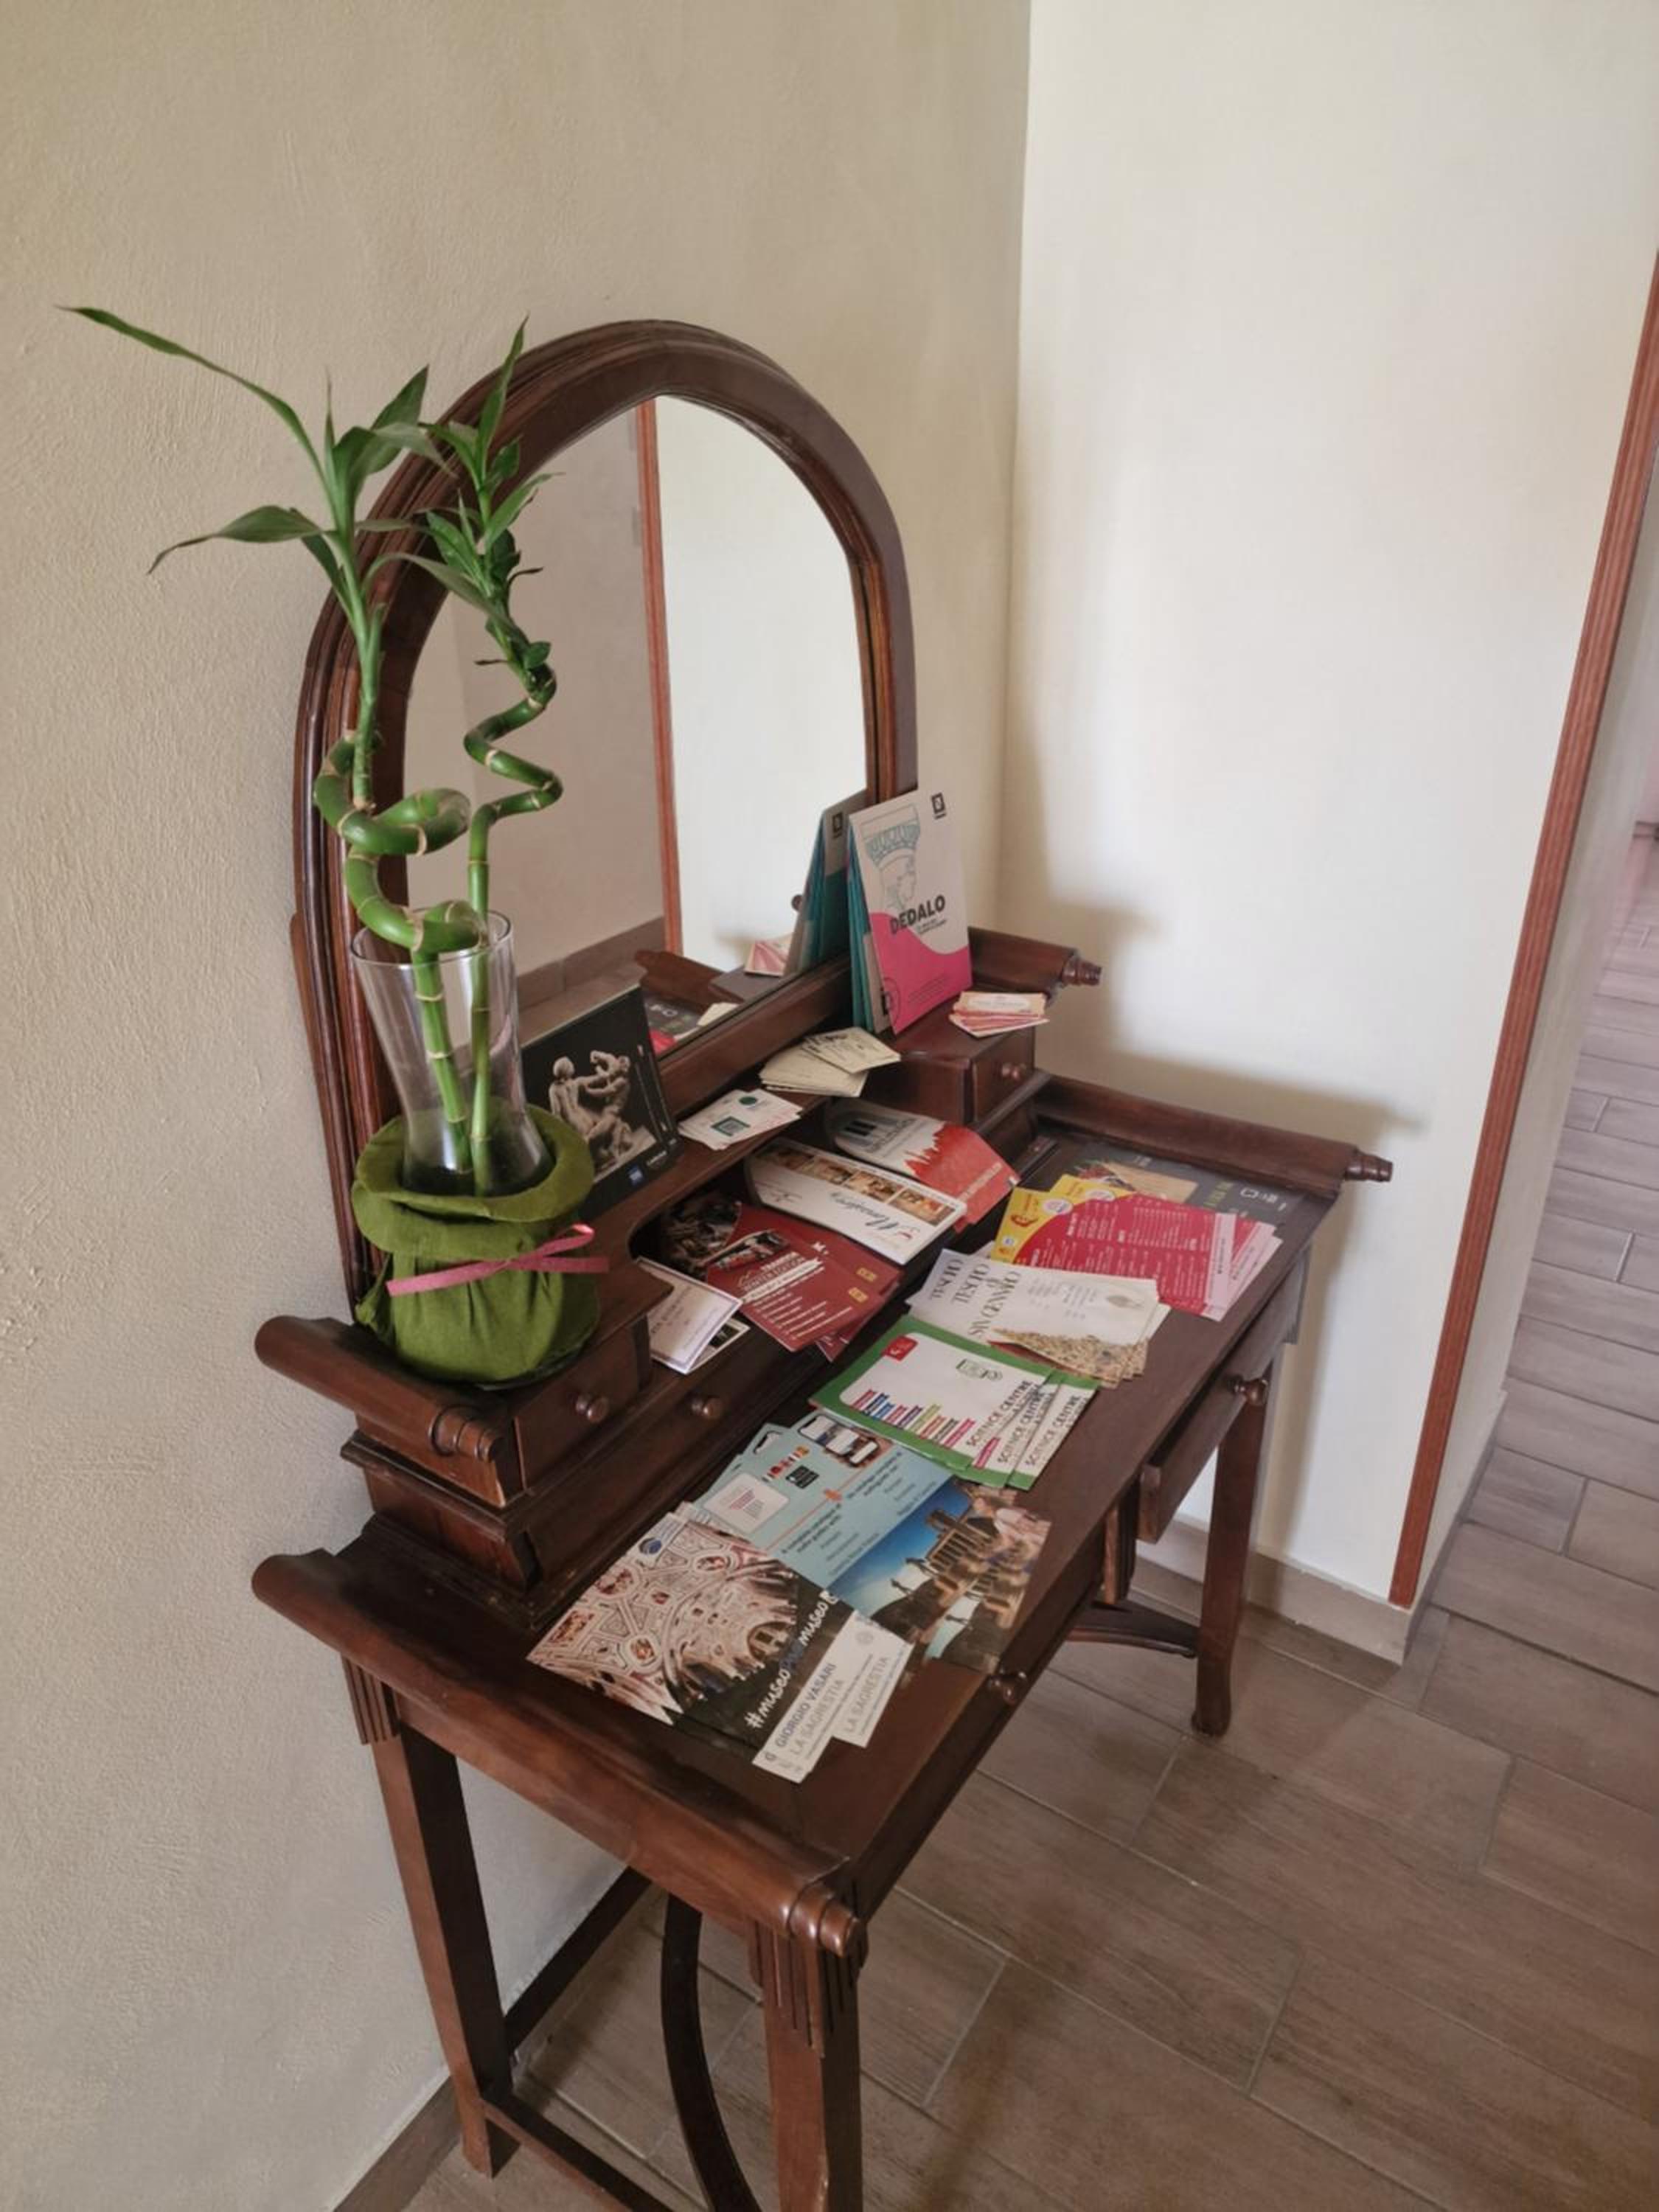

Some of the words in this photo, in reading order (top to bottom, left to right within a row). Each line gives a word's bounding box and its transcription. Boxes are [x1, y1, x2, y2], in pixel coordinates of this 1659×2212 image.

[890, 894, 946, 936] DEDALO
[967, 1411, 1002, 1446] SCIENCE
[1000, 1380, 1033, 1411] CENTRE
[774, 1702, 811, 1747] GIORGIO
[807, 1662, 837, 1702] VASARI
